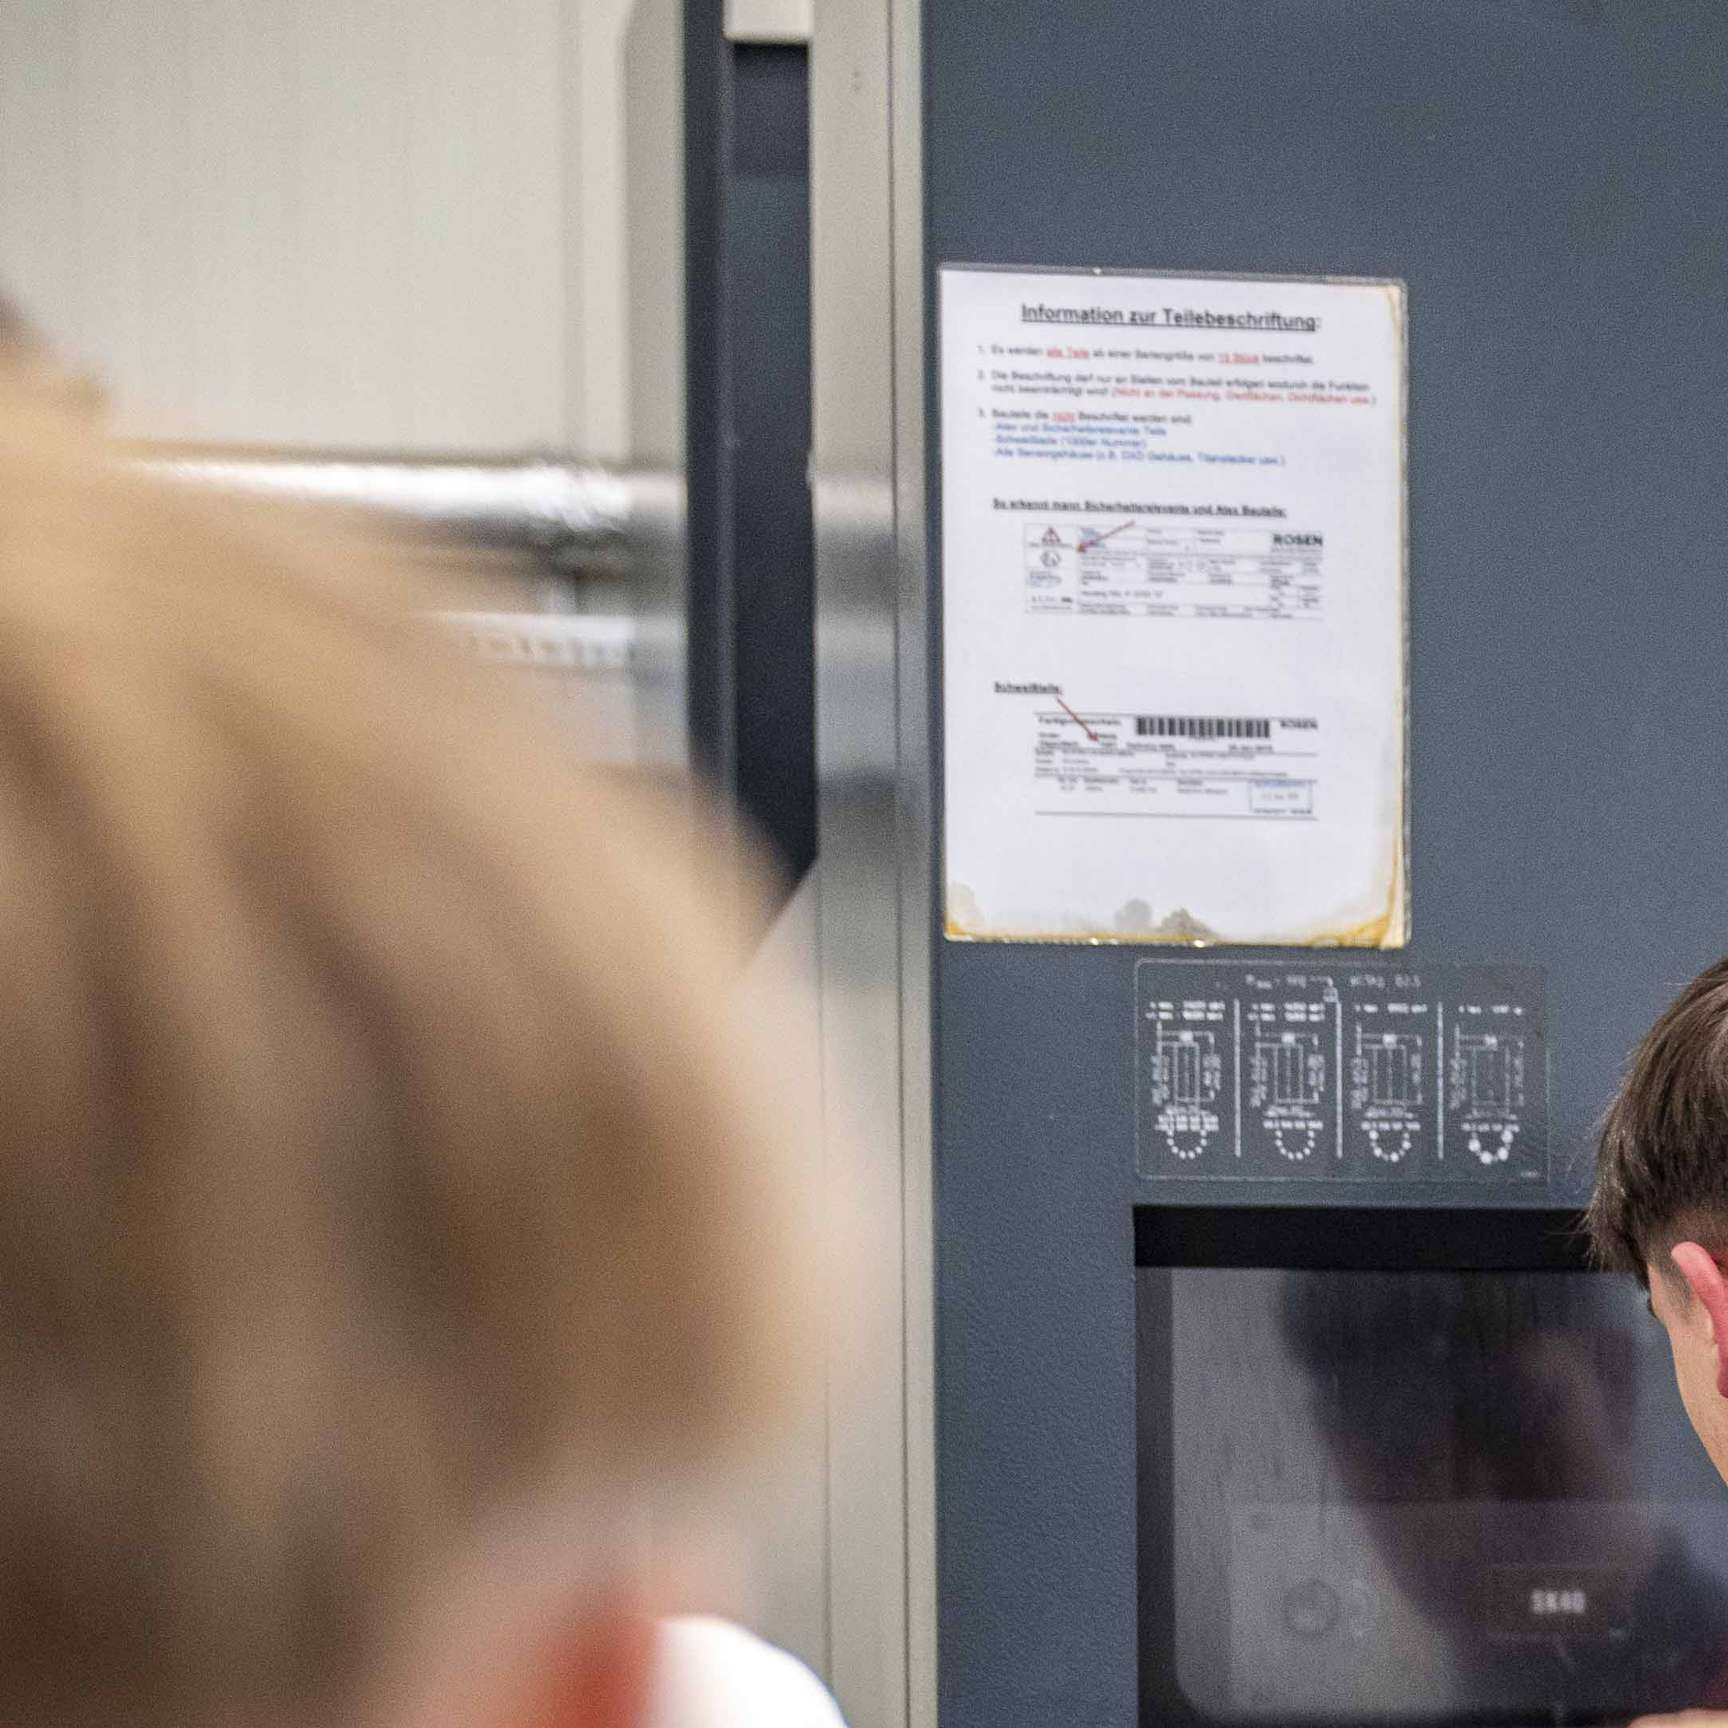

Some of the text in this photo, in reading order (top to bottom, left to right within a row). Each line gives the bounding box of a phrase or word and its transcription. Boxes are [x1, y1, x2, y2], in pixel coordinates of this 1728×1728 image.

[1021, 303, 1123, 323] Information
[1130, 309, 1156, 325] zur
[1273, 533, 1323, 547] ROSEN
